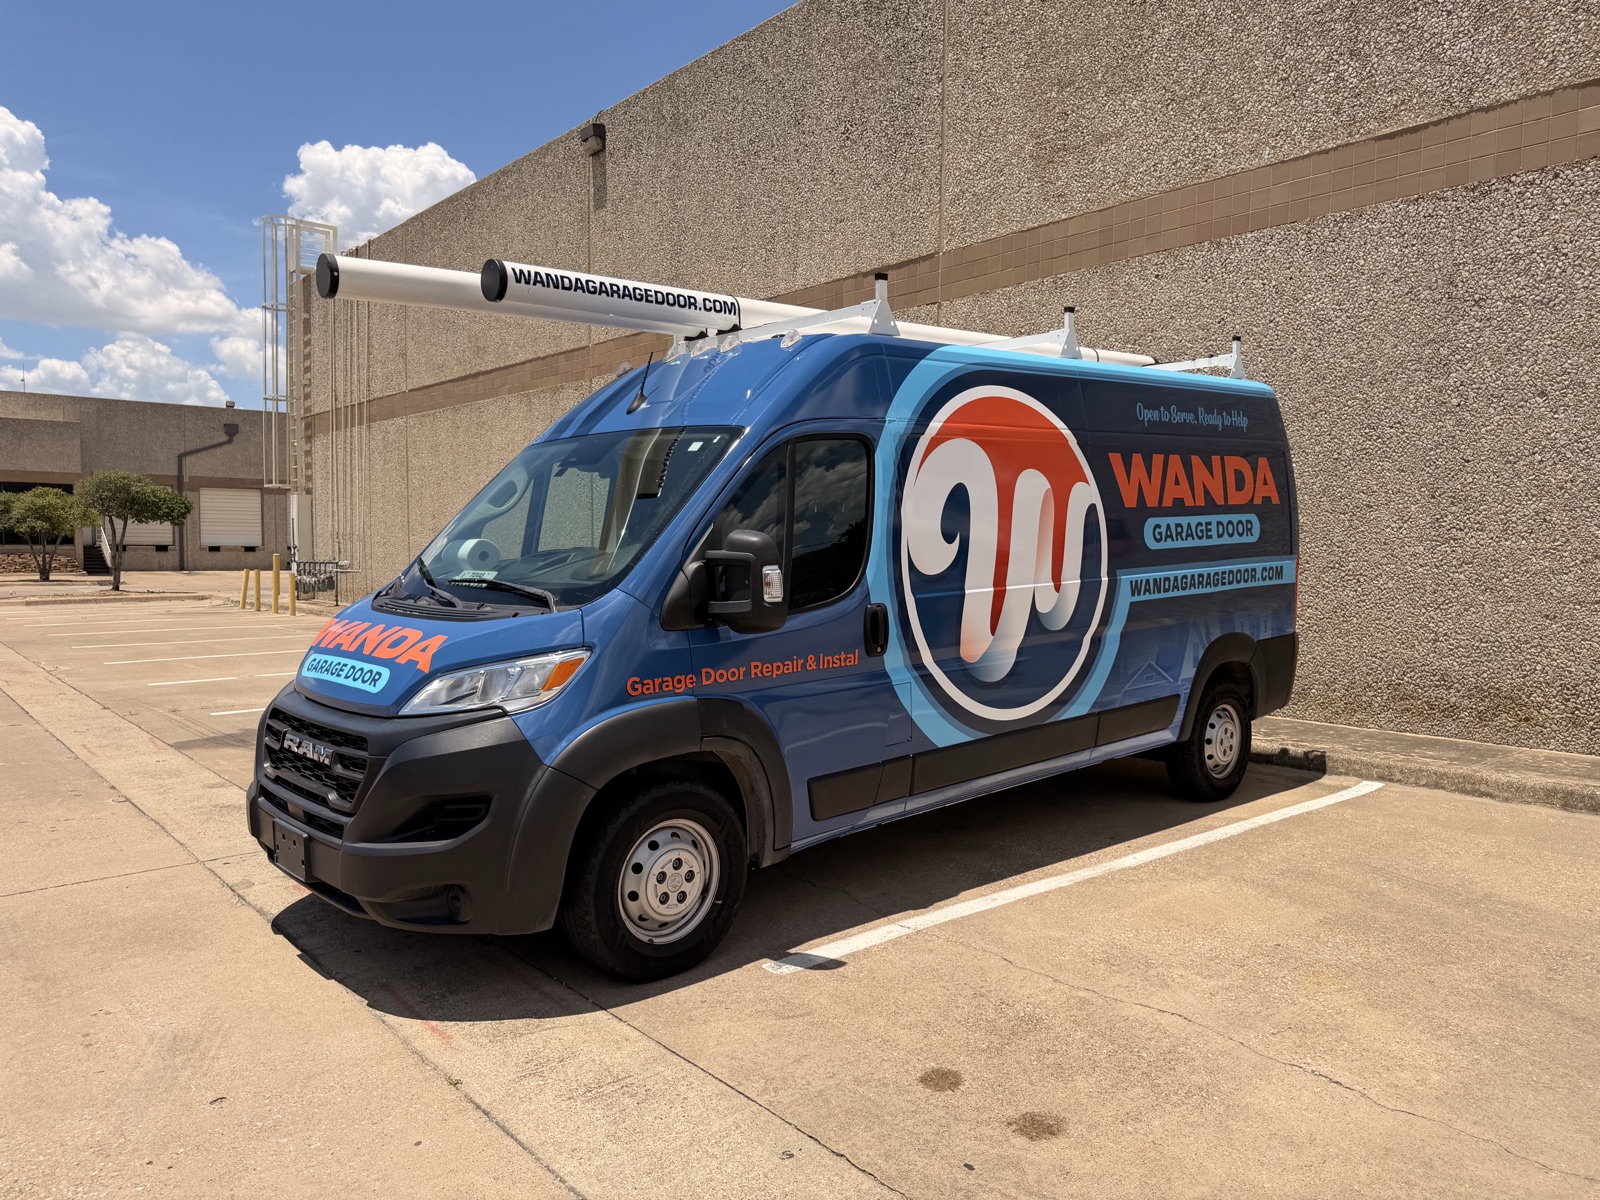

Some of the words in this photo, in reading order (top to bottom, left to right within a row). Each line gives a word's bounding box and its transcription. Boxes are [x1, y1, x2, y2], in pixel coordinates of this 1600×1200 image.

[511, 267, 738, 316] WANDAGARAGEDOOR.COM
[1136, 402, 1159, 427] Open
[1160, 406, 1170, 422] to
[1170, 405, 1198, 425] Serve,
[1198, 407, 1222, 431] Ready
[1222, 411, 1231, 426] to
[1231, 410, 1249, 432] Help
[1108, 452, 1280, 508] WANDA
[1152, 520, 1213, 543] GARAGE
[1216, 519, 1254, 539] DOOR
[1129, 565, 1284, 597] WANDAGARAGEDOOR.COM
[311, 617, 448, 674] WANDA
[306, 657, 348, 679] GARAGE
[343, 665, 383, 688] DOOR
[626, 673, 697, 696] Garage
[701, 665, 746, 686] Door
[750, 656, 804, 679] Repair
[806, 654, 817, 671] &
[819, 649, 859, 669] Instal
[283, 733, 334, 766] RAM
